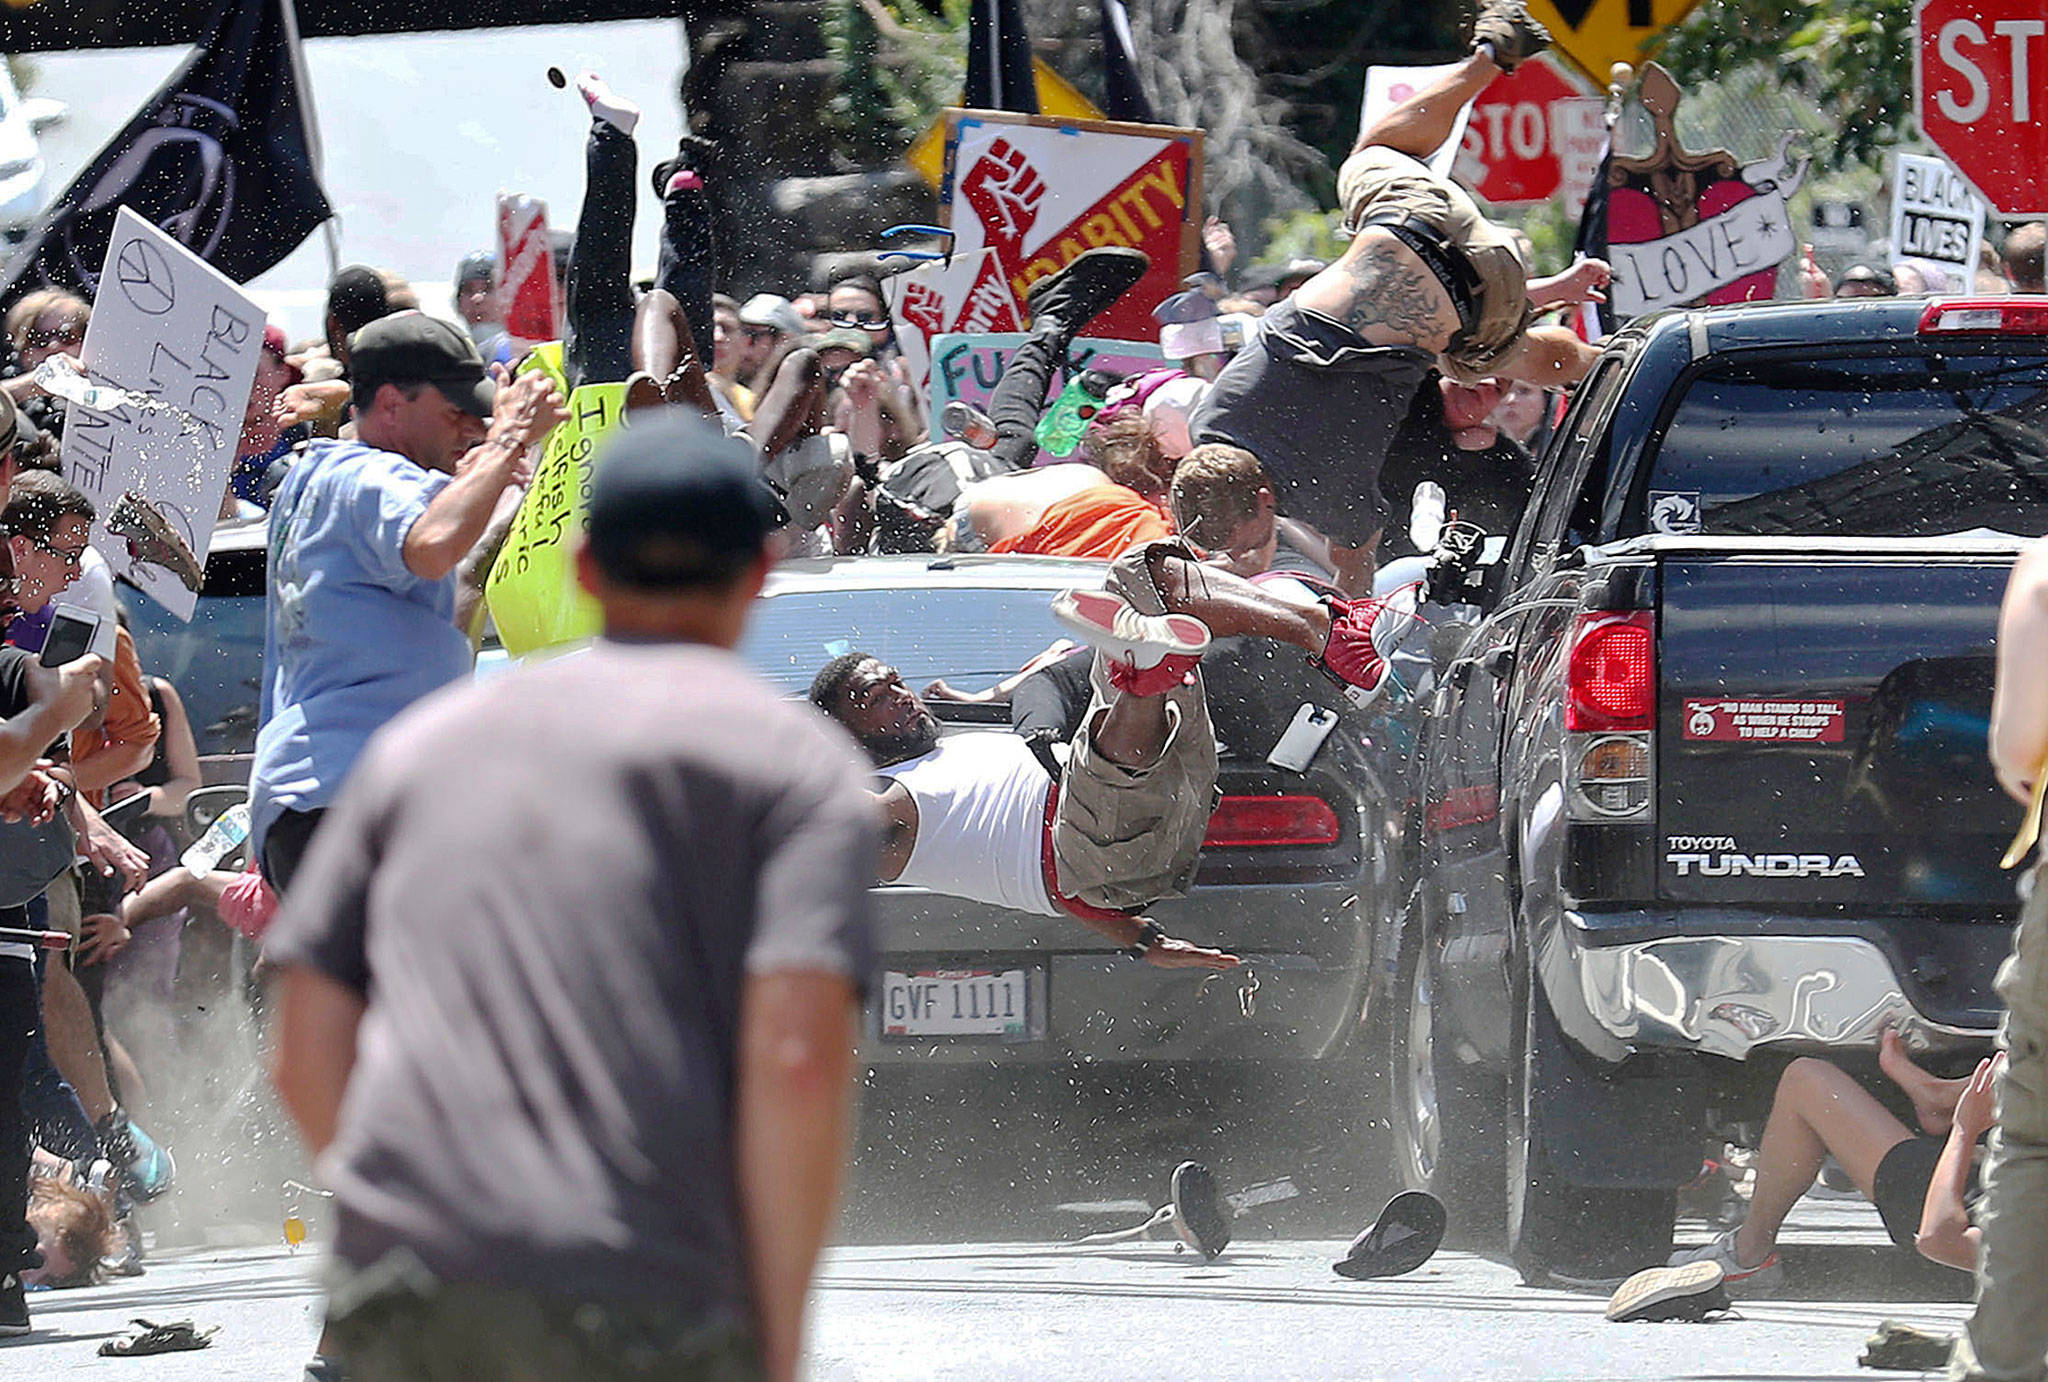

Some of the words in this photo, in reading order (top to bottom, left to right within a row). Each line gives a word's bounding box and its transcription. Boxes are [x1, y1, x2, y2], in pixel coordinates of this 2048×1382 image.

[1936, 18, 2046, 124] ST
[1626, 212, 1759, 301] LOVE
[1902, 214, 1969, 261] LIVES
[180, 303, 251, 451] BLACK
[939, 343, 1096, 397] FUK
[550, 424, 571, 546] elfish
[1732, 715, 1746, 725] AS
[1801, 704, 1815, 714] SO
[1738, 727, 1752, 737] TO
[1753, 727, 1779, 737] HELP
[1779, 728, 1787, 737] A
[1666, 835, 1737, 850] TOYOTA
[1666, 853, 1866, 877] TUNDRA
[889, 984, 939, 1020] GVF
[952, 982, 1015, 1019] 1111
